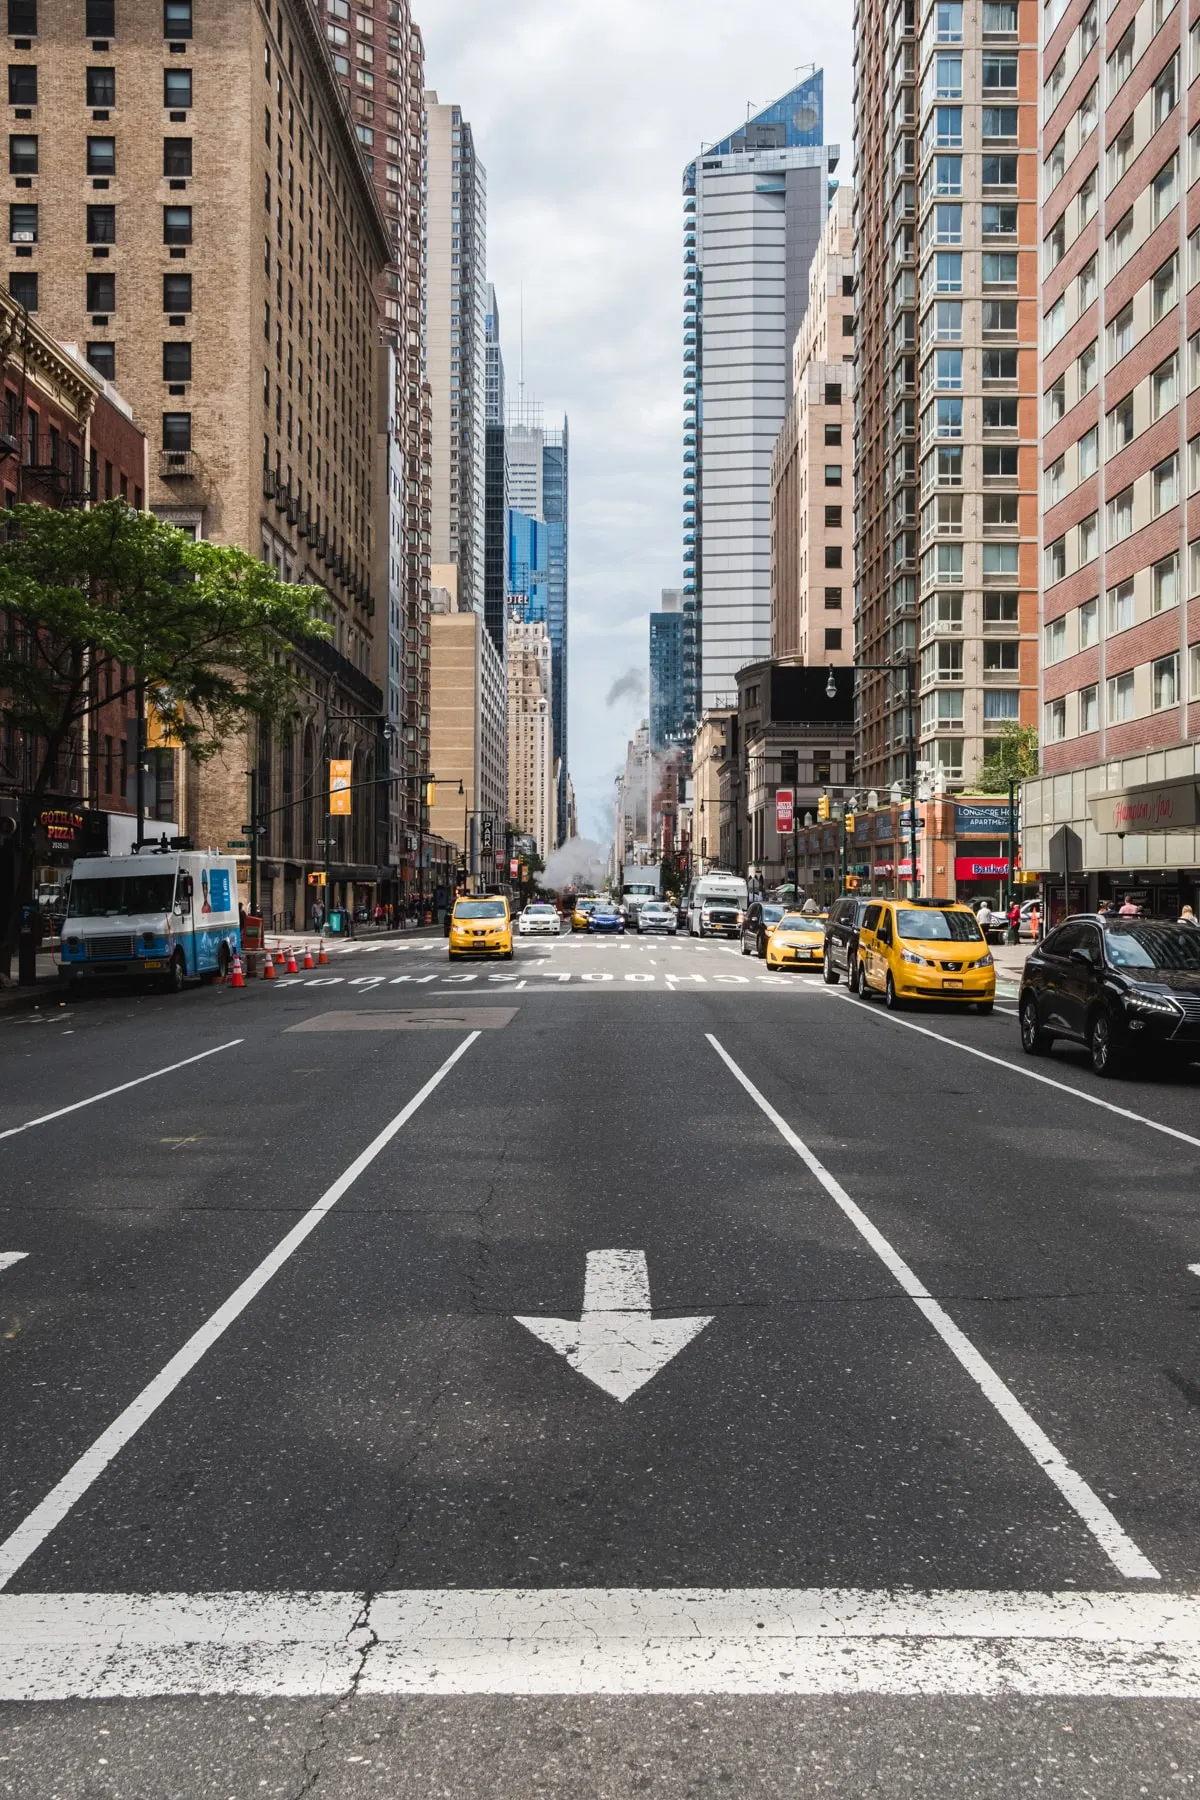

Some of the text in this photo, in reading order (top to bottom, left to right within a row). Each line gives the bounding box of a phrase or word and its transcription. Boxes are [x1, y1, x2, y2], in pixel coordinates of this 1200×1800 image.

[1113, 795, 1173, 828] Hampton Inn
[41, 811, 83, 829] GOTHAM
[48, 826, 75, 840] PIZZA
[972, 864, 997, 874] Bank
[274, 974, 519, 988] SCHOOL
[544, 973, 794, 984] SCHOOL
